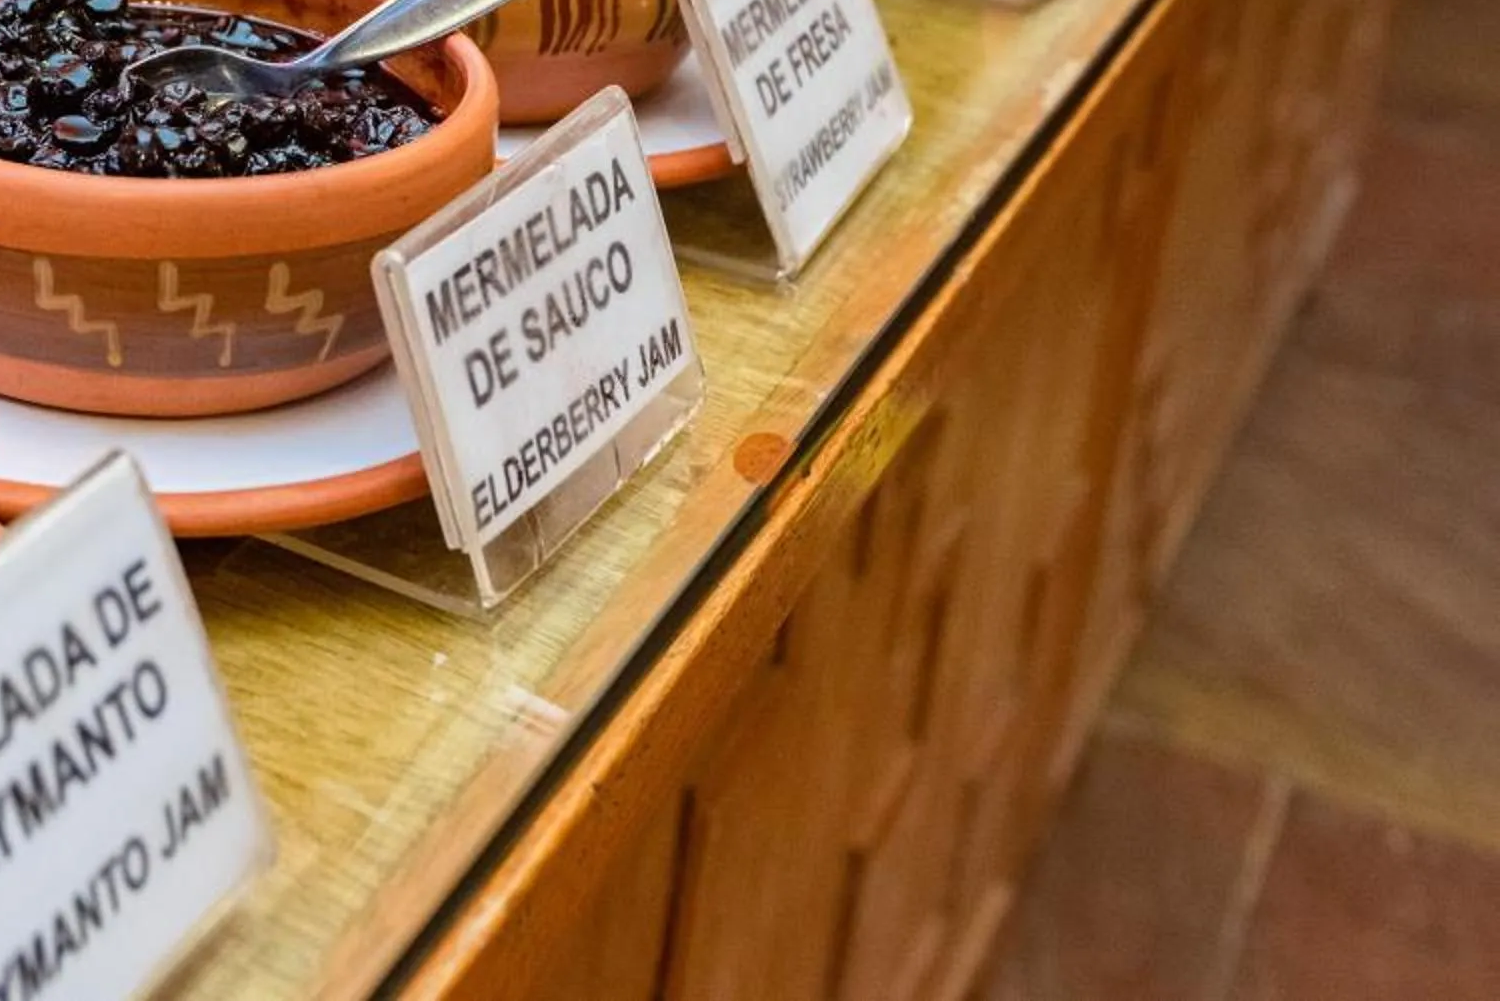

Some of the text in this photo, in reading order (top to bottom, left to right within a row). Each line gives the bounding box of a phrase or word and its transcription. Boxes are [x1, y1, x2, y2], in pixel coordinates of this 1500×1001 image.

[755, 2, 852, 119] DE FRESA
[424, 157, 635, 346] MERMELADA
[463, 241, 633, 408] DE SAUCO
[470, 318, 683, 530] ELDERBERRY JAM
[94, 558, 163, 647] DE
[161, 753, 231, 860] JAM
